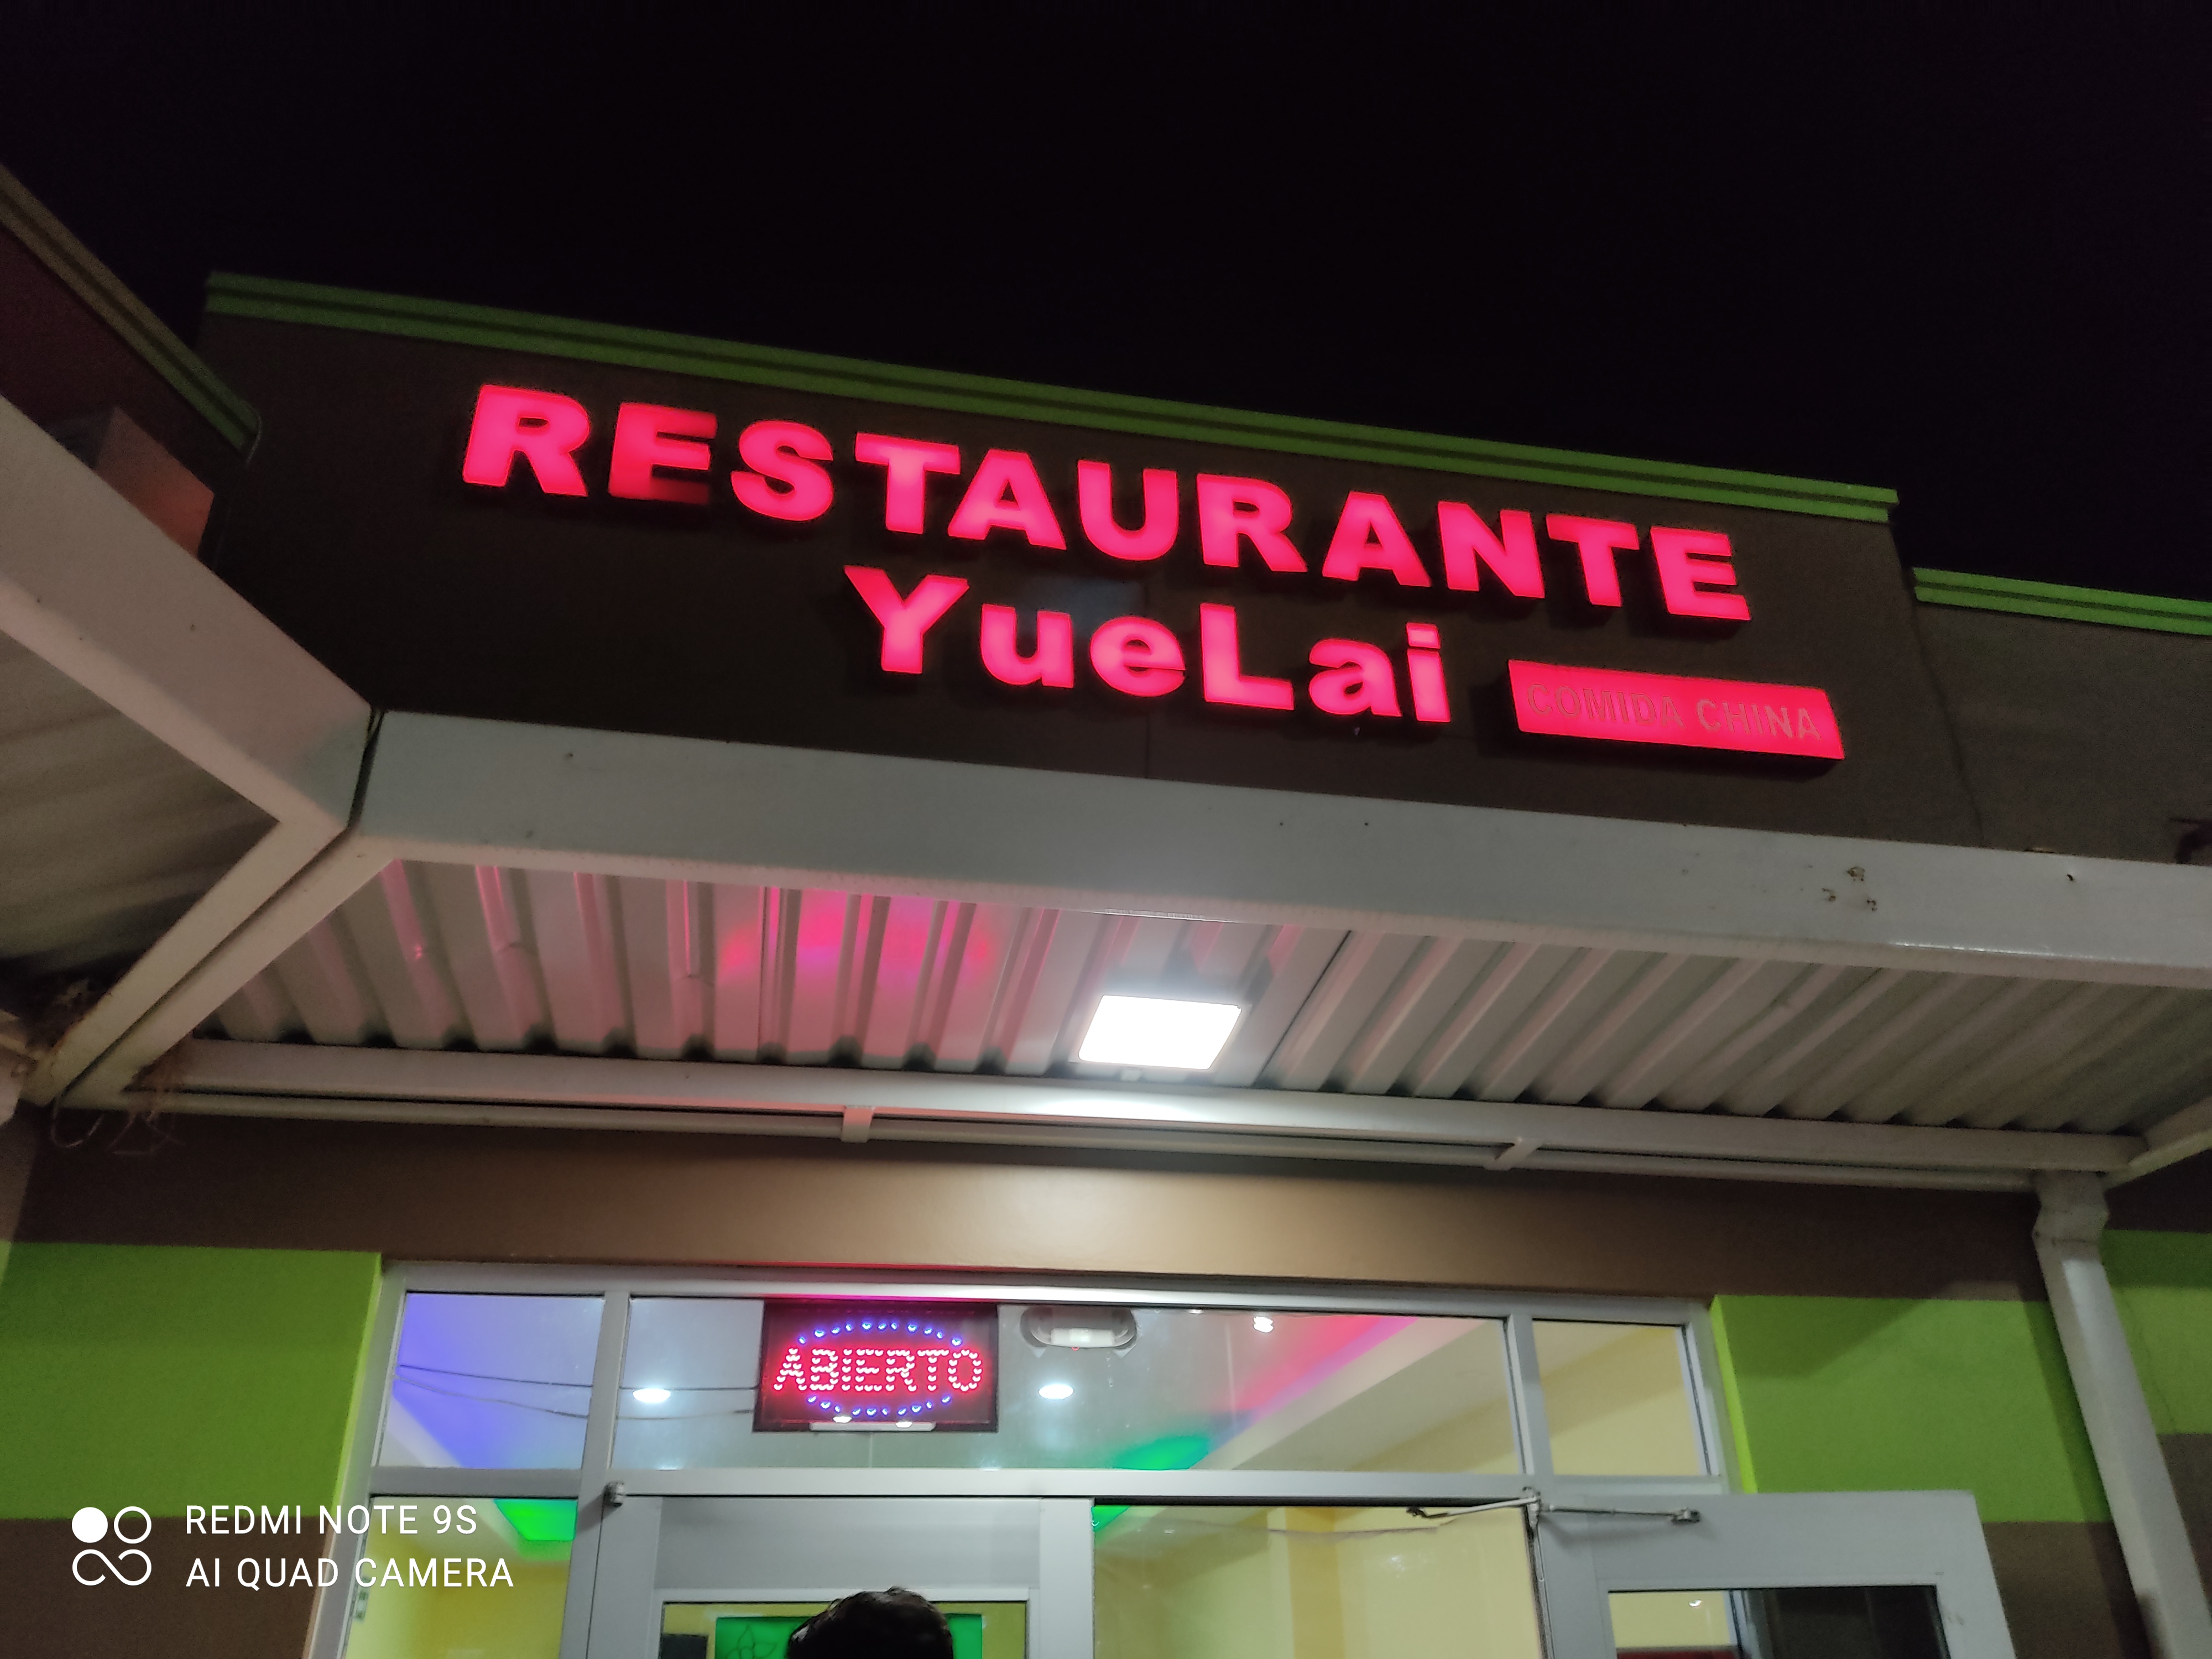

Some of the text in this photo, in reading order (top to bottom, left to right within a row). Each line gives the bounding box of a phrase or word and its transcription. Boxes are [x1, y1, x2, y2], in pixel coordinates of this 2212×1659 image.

[462, 384, 1751, 621] RESTAURANTE
[844, 566, 1451, 723] YueLai
[1526, 683, 1822, 740] COMIDA CHINA
[773, 1348, 983, 1392] ABIERTO
